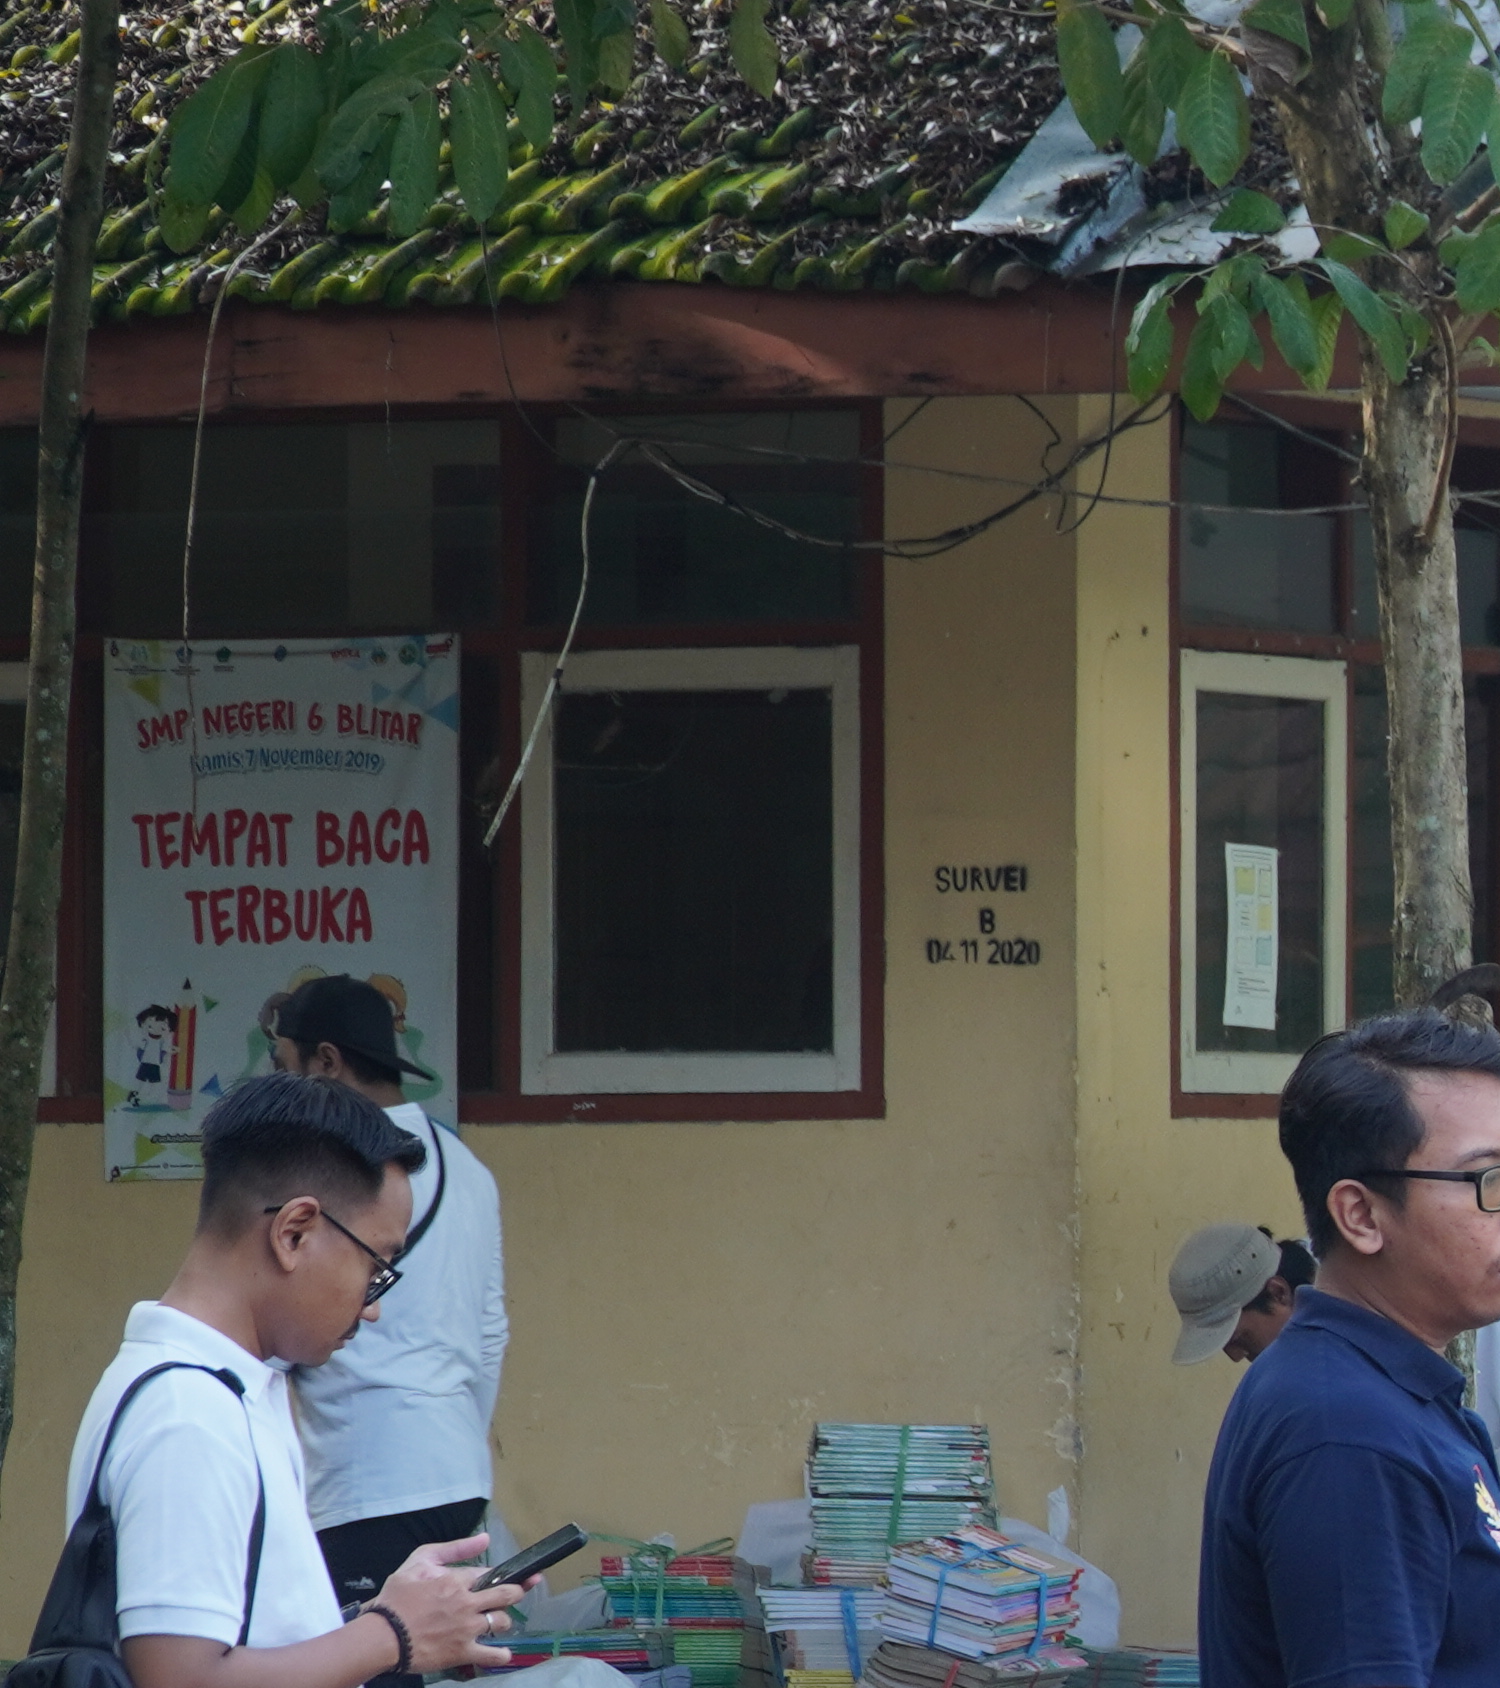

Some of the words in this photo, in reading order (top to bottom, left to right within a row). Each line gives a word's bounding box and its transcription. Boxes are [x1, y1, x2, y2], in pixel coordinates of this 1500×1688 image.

[137, 709, 189, 750] SMP
[202, 699, 294, 736] NEGERI
[307, 702, 323, 732] 6
[336, 704, 422, 745] BLITAR
[246, 749, 255, 765] 7
[344, 749, 382, 770] 2019
[132, 808, 294, 870] TEMPAT
[315, 808, 430, 868] BACA
[935, 865, 1028, 893] SURVEI
[185, 885, 373, 946] TERBUKA
[979, 908, 996, 934] B
[986, 937, 1041, 965] 2020
